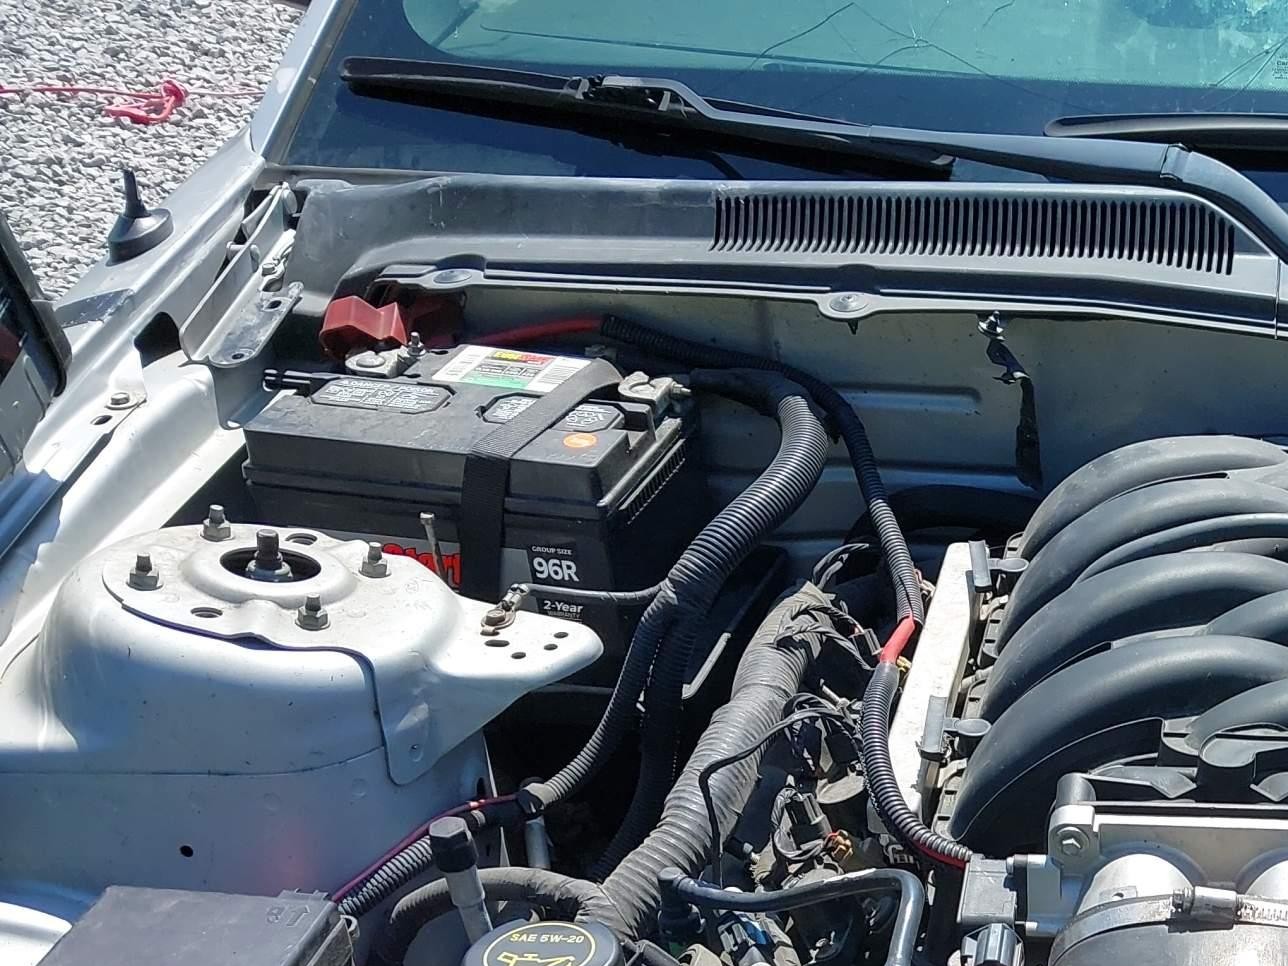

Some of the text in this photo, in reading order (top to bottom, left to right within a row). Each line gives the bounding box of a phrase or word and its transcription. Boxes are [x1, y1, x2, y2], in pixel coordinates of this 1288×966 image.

[533, 557, 580, 581] 96R
[543, 600, 584, 613] 2-Year
[510, 933, 585, 943] SAE 5W-20
